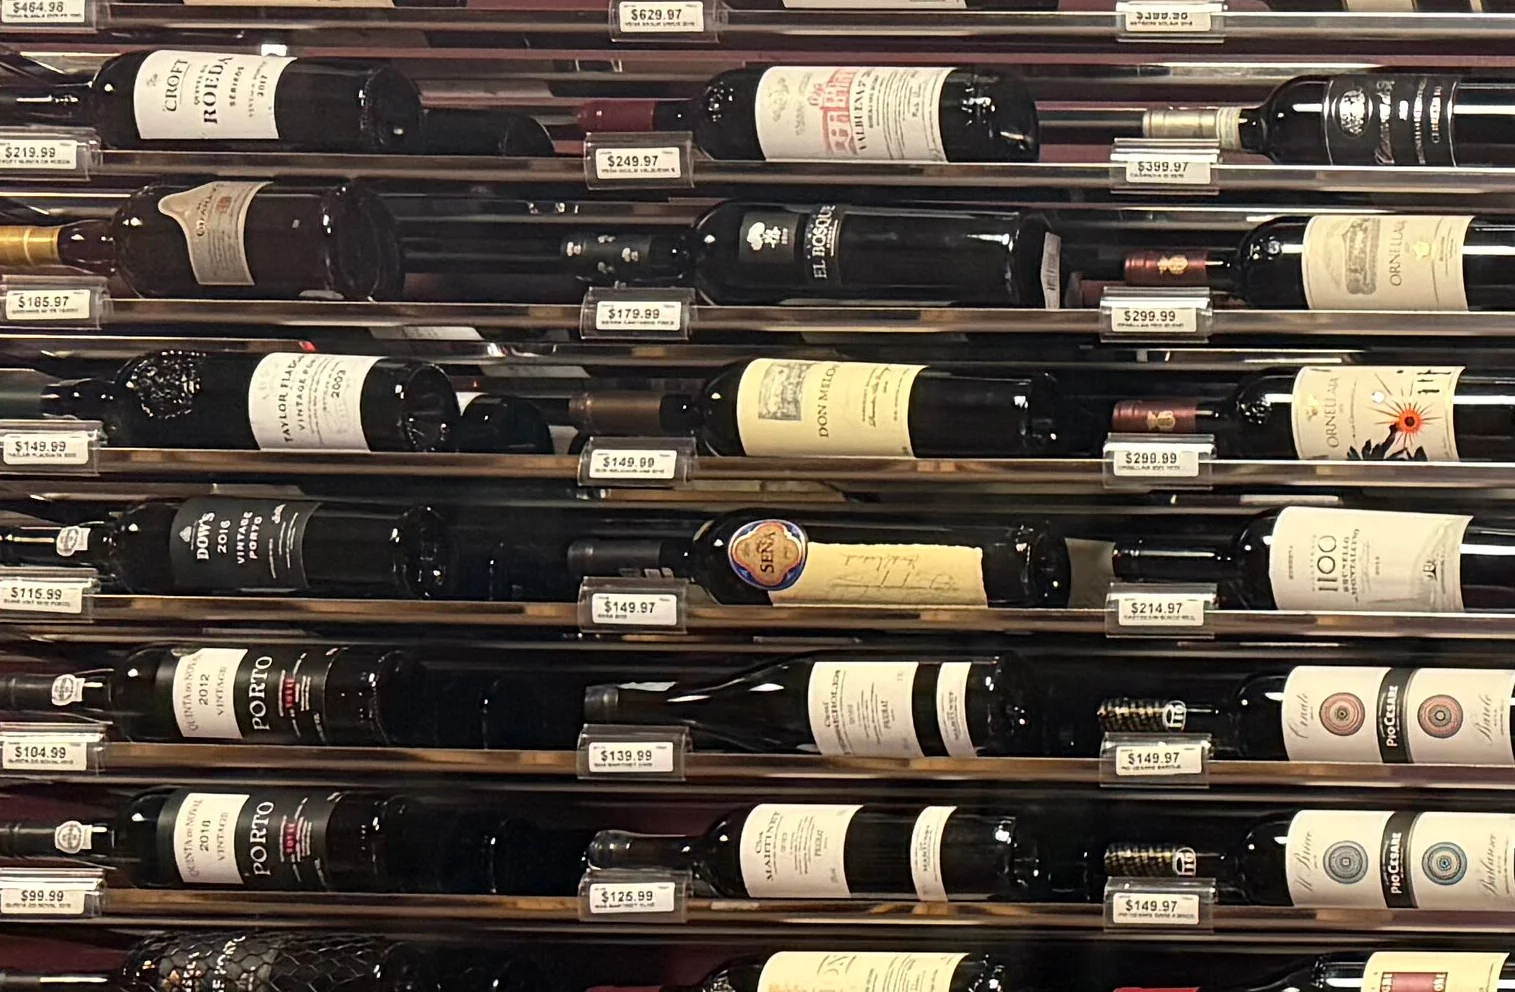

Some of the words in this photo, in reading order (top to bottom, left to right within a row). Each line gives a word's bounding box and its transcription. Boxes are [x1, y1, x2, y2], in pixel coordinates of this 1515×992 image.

[631, 8, 682, 21] $629.97
[162, 59, 189, 112] CROFT
[201, 57, 232, 125] ROEDA
[5, 146, 56, 159] $219.99
[607, 155, 658, 168] $249.97
[1137, 160, 1189, 173] $399.97
[814, 260, 826, 278] EL
[1123, 310, 1176, 322] $299.99
[297, 379, 308, 431] VINTAGE
[279, 394, 294, 442] TAYLOR
[817, 404, 828, 437] DON
[603, 456, 655, 468] $149.99
[1125, 451, 1177, 464] $299.99
[196, 513, 215, 560] DOW'S
[218, 520, 230, 553] 2016
[237, 512, 252, 564] VINTAGE
[249, 516, 262, 558] PORTO
[604, 600, 655, 614] $149.97
[1131, 602, 1183, 615] $214.97
[199, 674, 210, 705] 2012
[249, 656, 273, 730] PORTO
[14, 746, 66, 759] $104.99
[600, 749, 652, 762] $139.99
[1127, 751, 1180, 765] $149.97
[200, 820, 211, 852] 2018
[250, 801, 275, 875] PORTO
[20, 889, 64, 902] $99.99
[1125, 899, 1178, 912] $149.97
